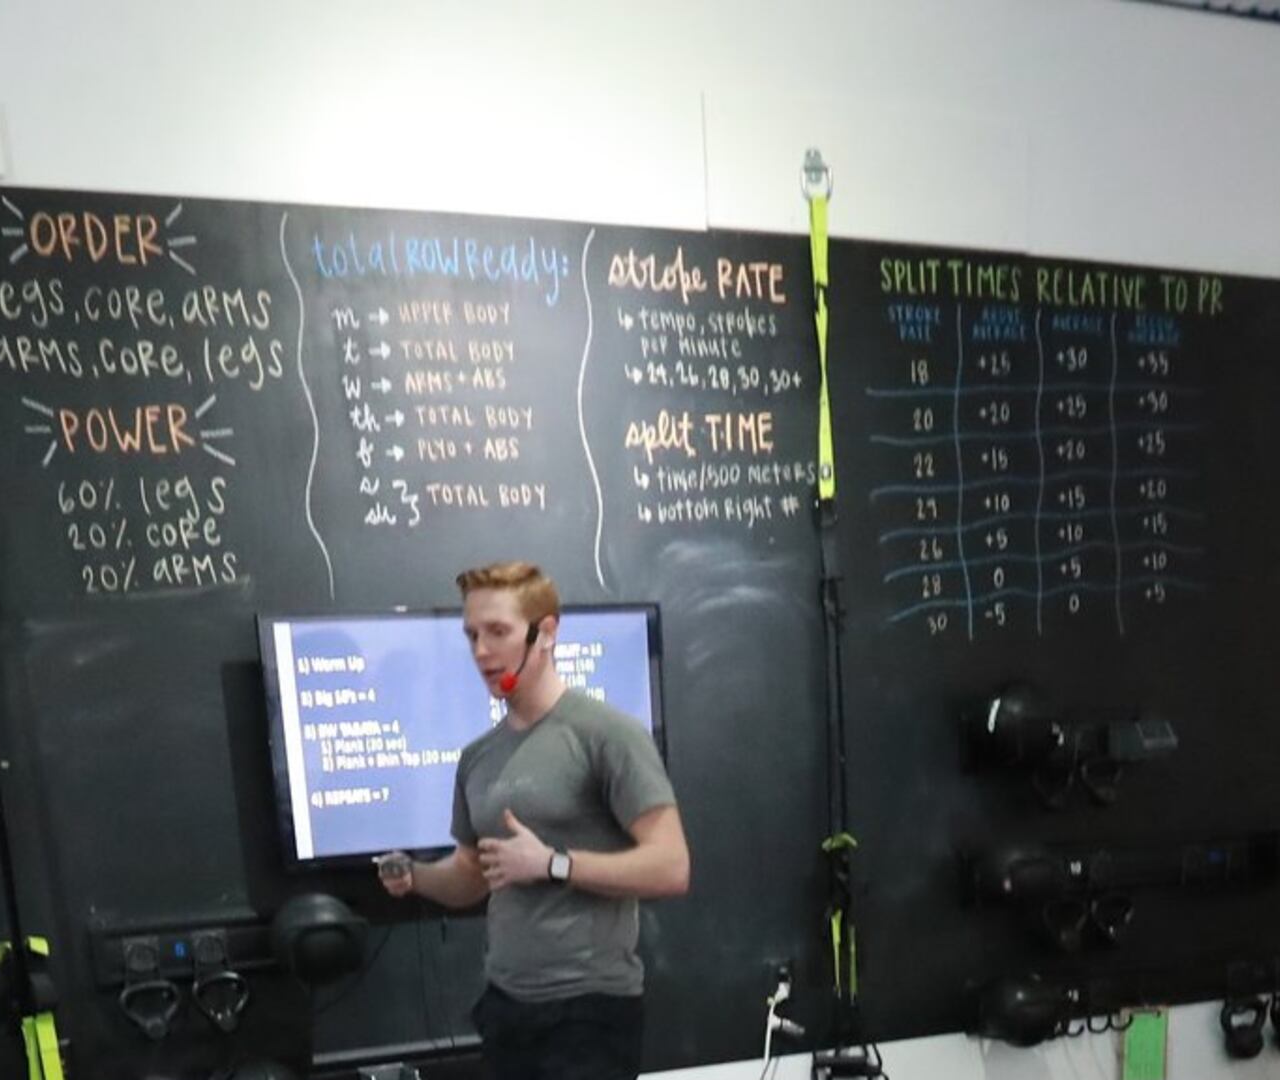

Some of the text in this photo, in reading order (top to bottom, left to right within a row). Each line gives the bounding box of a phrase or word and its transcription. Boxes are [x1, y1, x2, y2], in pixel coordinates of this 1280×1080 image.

[29, 210, 163, 267] ORDER
[716, 257, 788, 304] RATE
[879, 257, 1224, 317] SPLIT TIMES RELATIVE TO PR
[463, 302, 512, 324] BODY
[399, 339, 459, 363] TOTAL
[469, 341, 515, 363] BODY
[404, 370, 507, 396] ARMS ABS
[910, 359, 929, 386] 18
[59, 404, 196, 454] POWER
[415, 405, 474, 429] TOTAL
[484, 405, 534, 429] BODY
[912, 407, 935, 432] 20
[704, 410, 775, 454] TIME
[484, 436, 523, 461] ABS
[425, 481, 548, 511] TOTAL BODY
